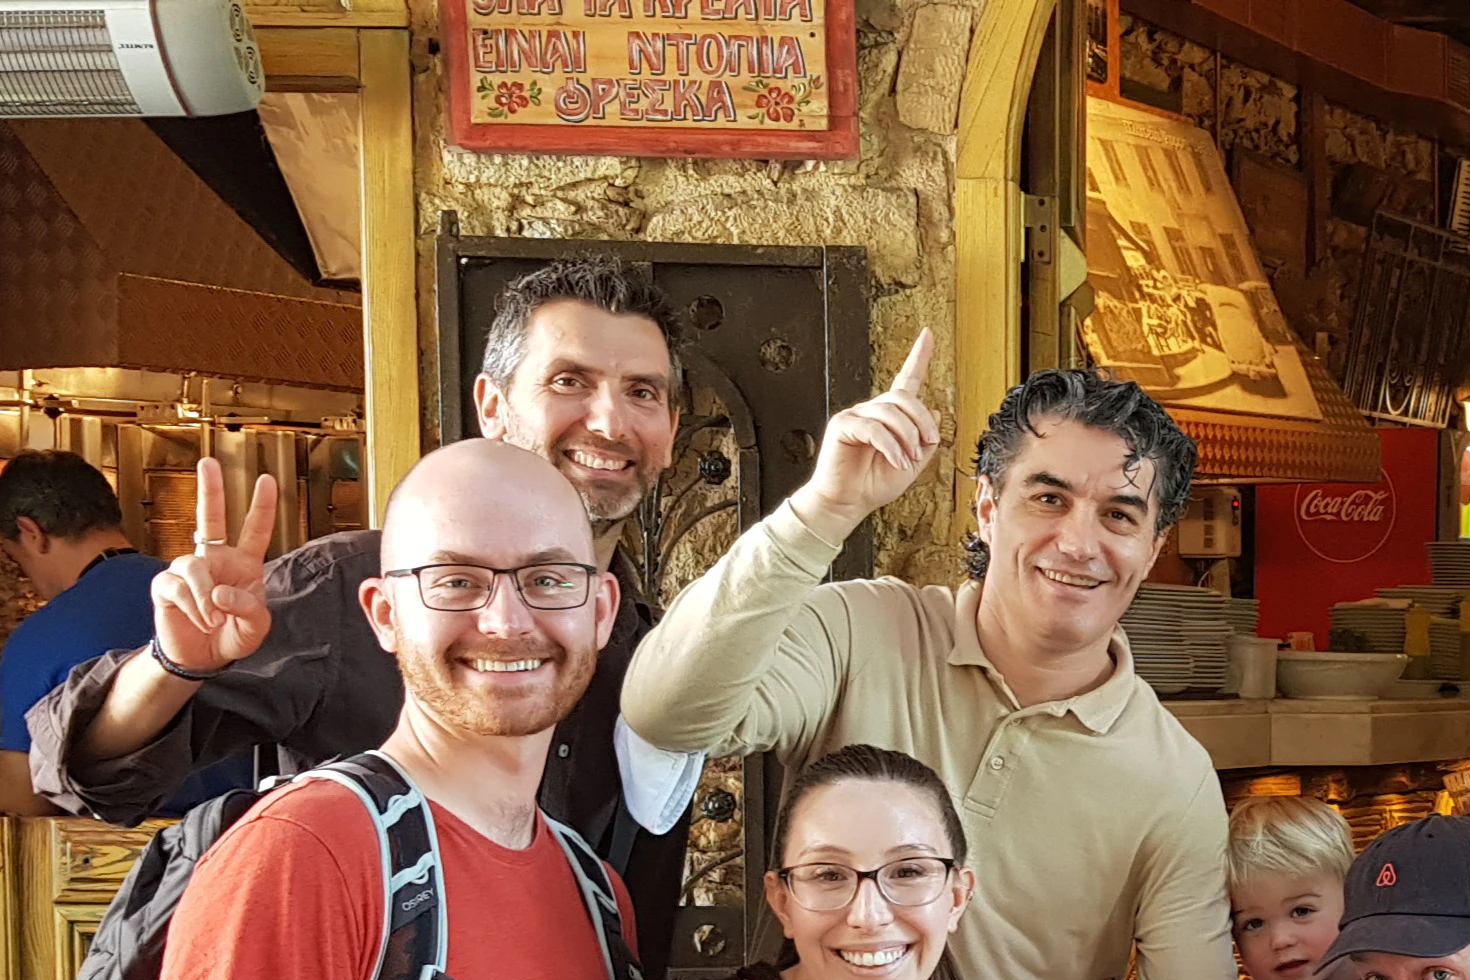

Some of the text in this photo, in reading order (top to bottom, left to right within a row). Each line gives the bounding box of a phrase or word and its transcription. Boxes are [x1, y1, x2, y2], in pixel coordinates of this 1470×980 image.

[472, 28, 808, 78] ΕΙΝΑΙ ΝΤΟΠΙΑ
[553, 77, 737, 122] ΦΡΕΣΚΑ
[1300, 489, 1390, 521] Coca-Cola
